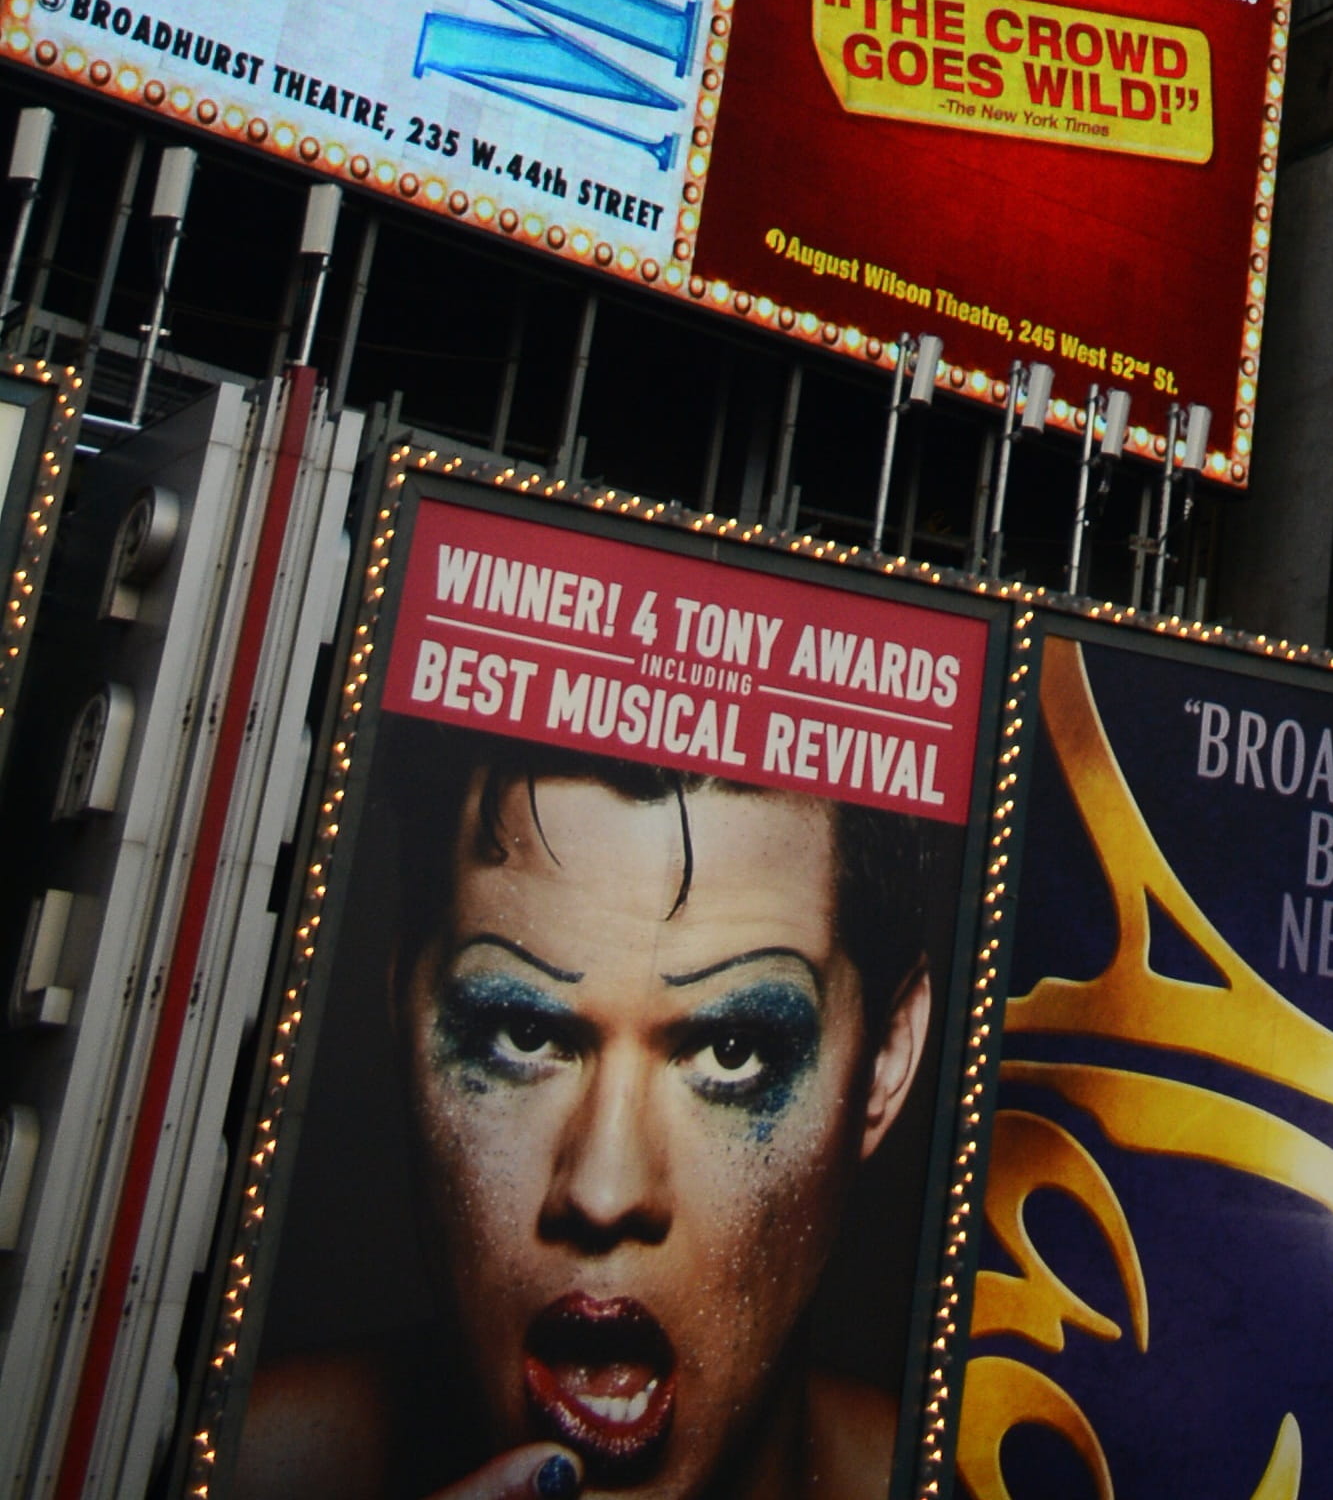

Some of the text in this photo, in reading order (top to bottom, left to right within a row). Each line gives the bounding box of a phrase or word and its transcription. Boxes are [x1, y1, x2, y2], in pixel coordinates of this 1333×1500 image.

[842, 34, 1199, 125] GOES WILD!”
[985, 8, 1188, 80] CROWD
[272, 64, 395, 141] THEATRE,
[405, 116, 460, 157] 235
[471, 138, 568, 199] W.44th
[577, 179, 664, 231] STREET
[981, 106, 1018, 122] New
[1022, 111, 1058, 131] York
[1065, 118, 1109, 137] Times
[785, 236, 1179, 396] August Wilson Theatre, 245 West 52nd St.
[436, 543, 960, 707] WINNER! 4 TONY AWARDS
[640, 653, 753, 696] INCLUDING
[410, 640, 944, 805] BEST MUSICAL REVIVAL
